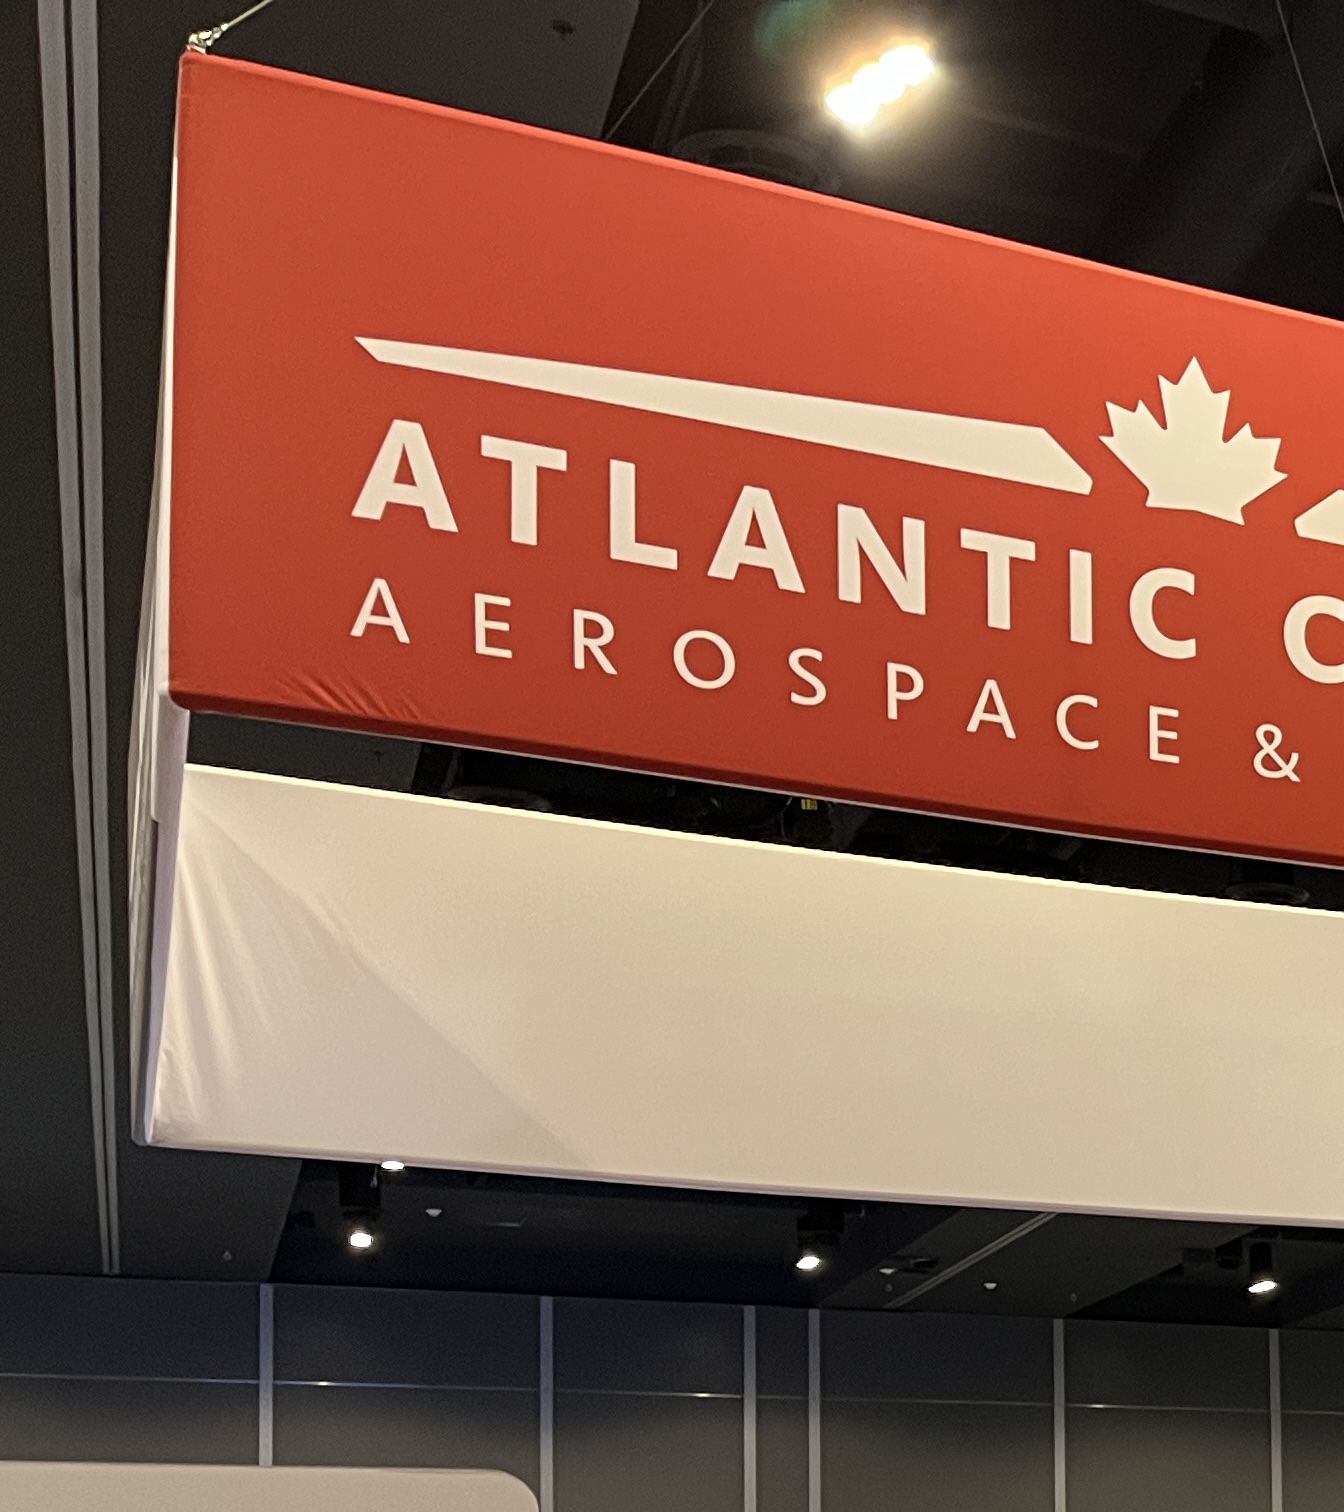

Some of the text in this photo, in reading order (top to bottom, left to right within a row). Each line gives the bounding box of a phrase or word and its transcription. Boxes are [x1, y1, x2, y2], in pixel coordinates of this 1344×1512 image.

[351, 418, 1197, 660] ATLANTIC
[350, 578, 1181, 765] AEROSPACE
[1252, 723, 1300, 782] &
